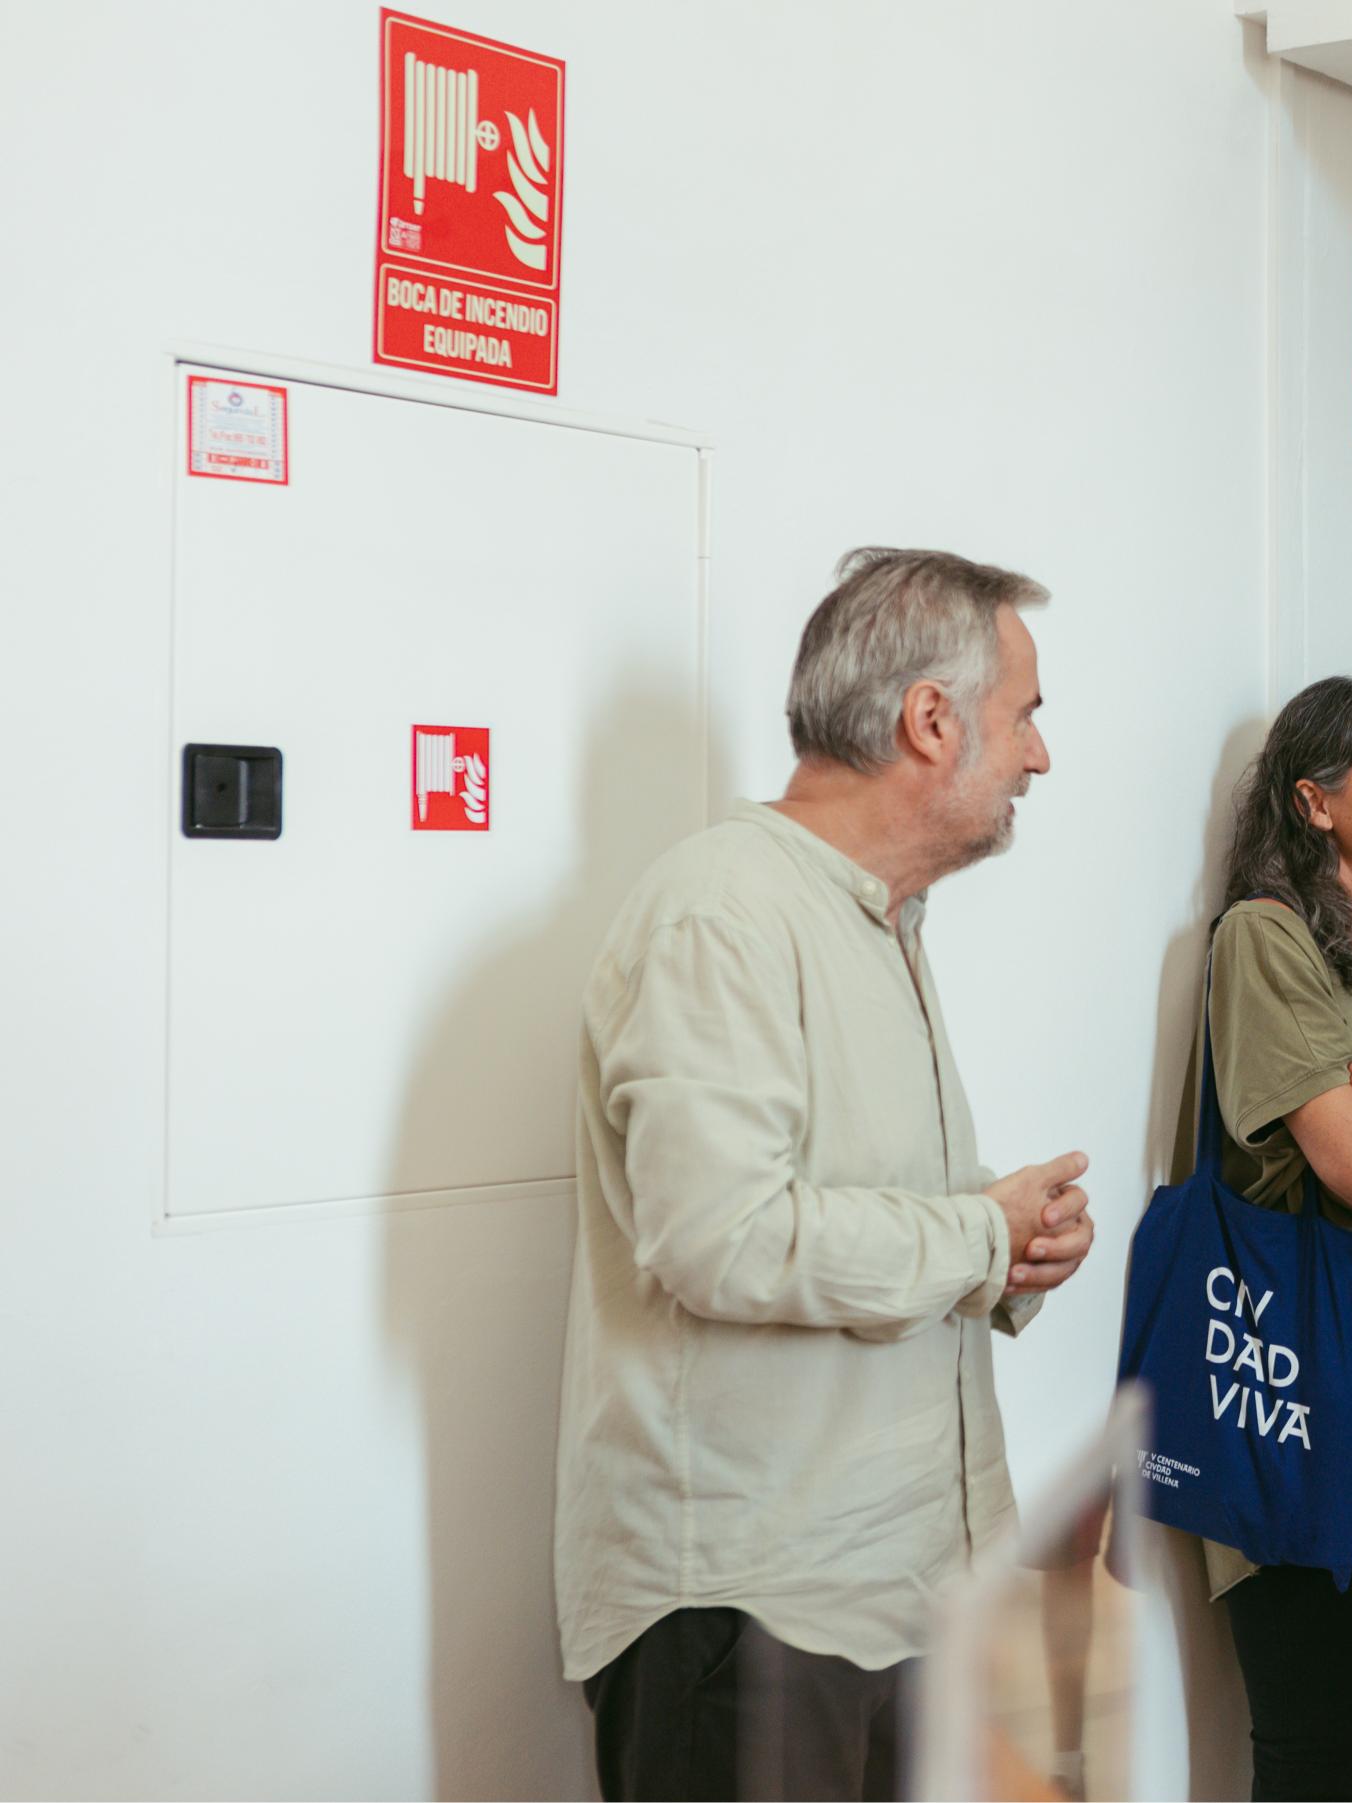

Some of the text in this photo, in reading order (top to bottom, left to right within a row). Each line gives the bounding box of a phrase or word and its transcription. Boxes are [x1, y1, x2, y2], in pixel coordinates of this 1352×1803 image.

[387, 277, 548, 337] BOCA DE INCENDIO
[423, 323, 513, 369] EQUIPADA
[1206, 1319, 1300, 1388] DAD
[1209, 1374, 1312, 1450] VIVA
[1142, 1469, 1179, 1488] DE VILLENA
[1156, 1454, 1201, 1477] CENTENARIO
